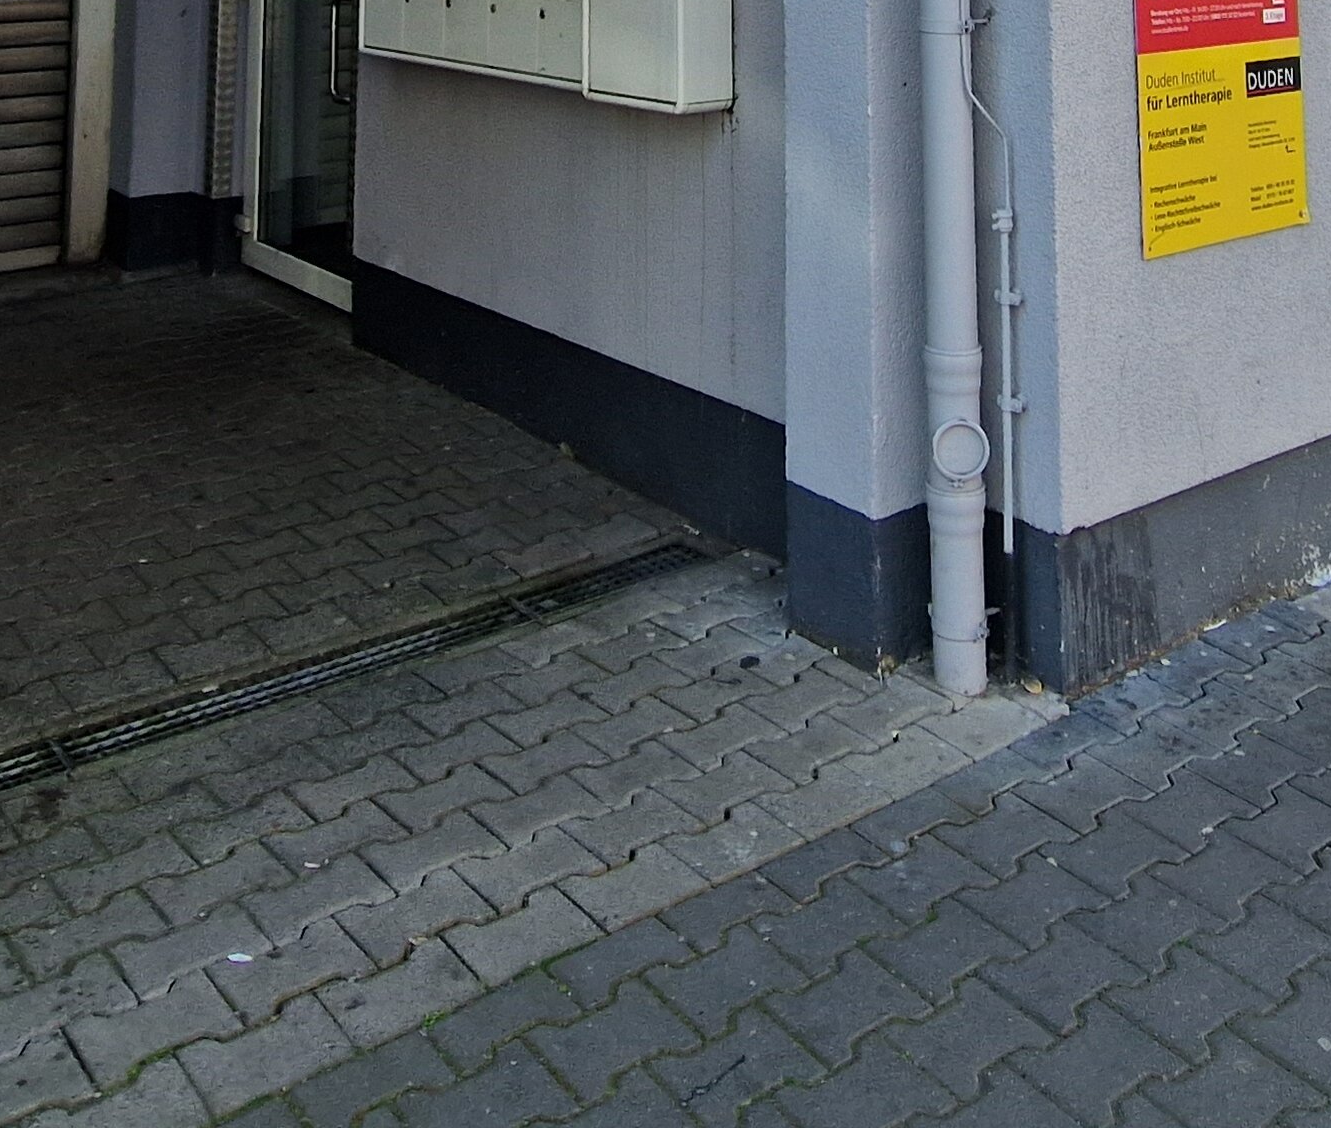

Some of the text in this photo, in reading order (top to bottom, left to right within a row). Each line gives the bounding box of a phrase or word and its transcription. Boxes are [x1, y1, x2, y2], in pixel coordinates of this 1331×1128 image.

[1146, 69, 1217, 90] Duden Institut
[1247, 67, 1294, 91] DUDEN
[1146, 87, 1232, 111] für Lerntherapie
[1147, 123, 1207, 140] Frankfurt am Main
[1188, 135, 1204, 145] West
